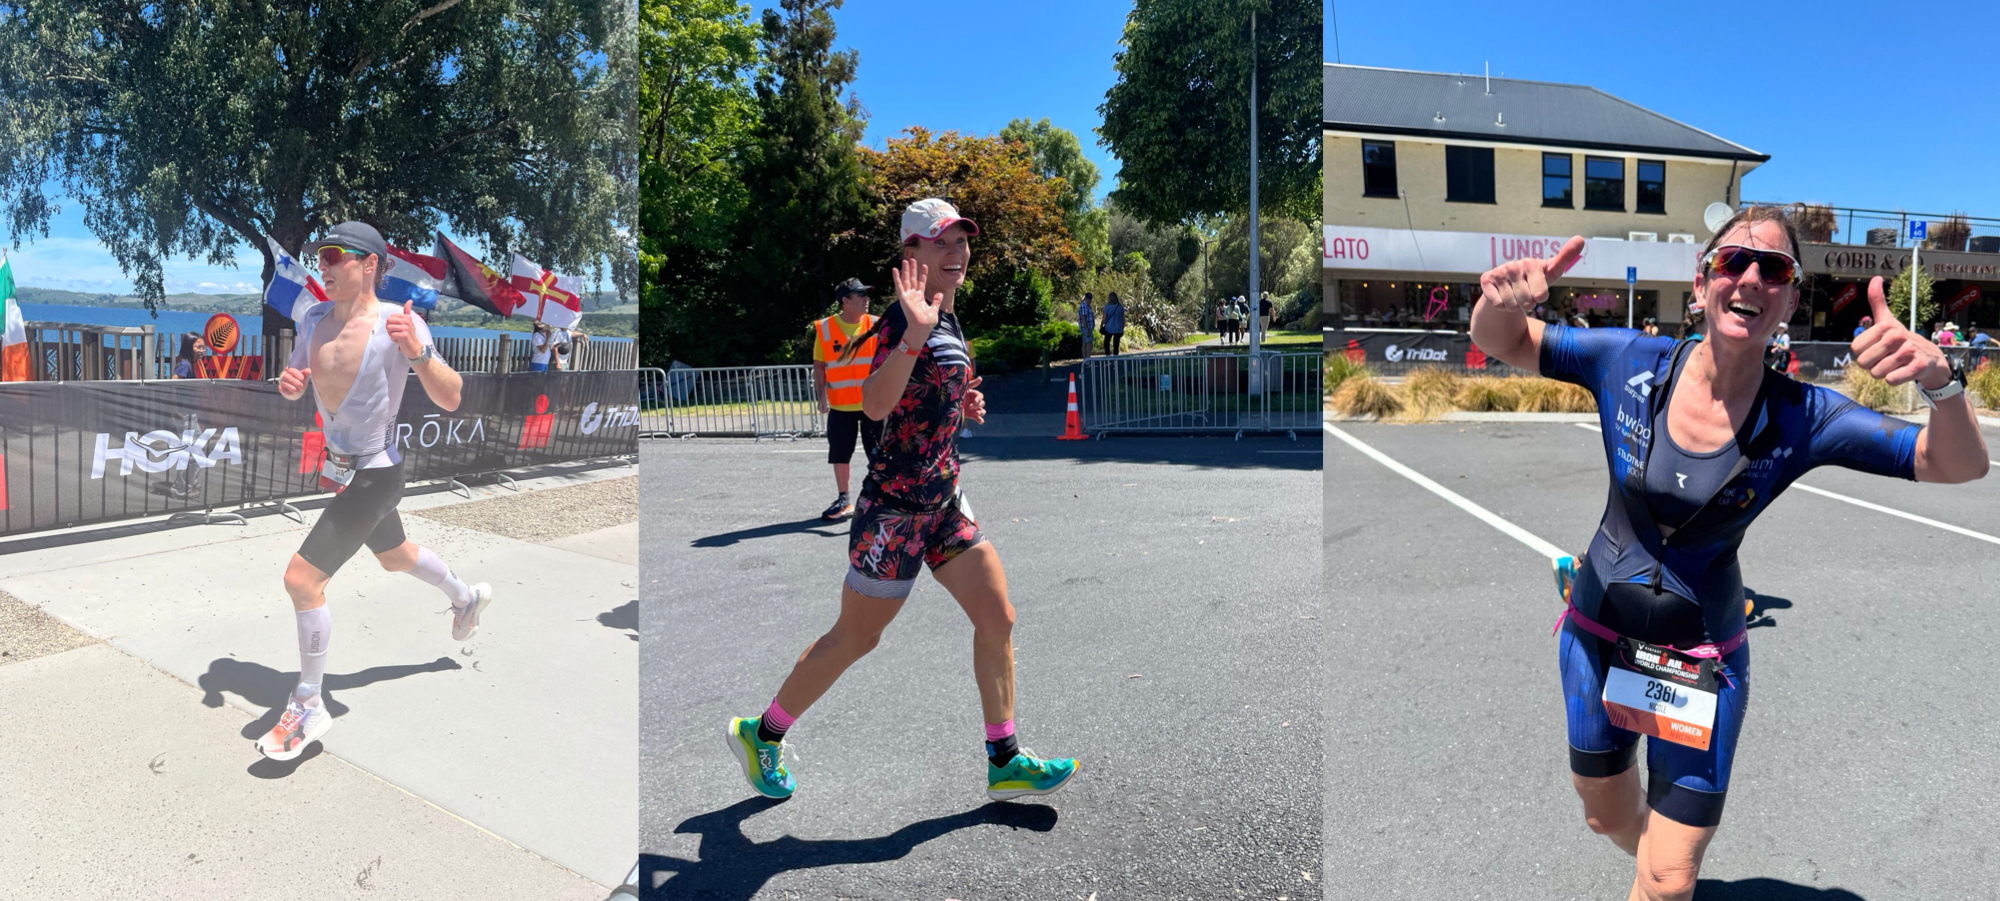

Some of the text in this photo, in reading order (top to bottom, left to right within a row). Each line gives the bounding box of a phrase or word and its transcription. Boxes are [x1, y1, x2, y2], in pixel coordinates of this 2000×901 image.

[1323, 237, 1369, 260] LATO
[1824, 250, 1877, 269] COBB
[1880, 253, 1896, 270] &
[1405, 348, 1448, 361] TriDot
[1623, 384, 1646, 404] surpas
[90, 426, 242, 480] HOKA
[1747, 458, 1774, 470] um
[1634, 658, 1655, 669] WORLD
[1655, 664, 1699, 680] CHAMPIONSHIP
[1635, 650, 1683, 669] IRONMAN
[1645, 680, 1677, 704] 2361
[1648, 702, 1667, 714] NICOLE
[1670, 722, 1703, 738] WOMEN
